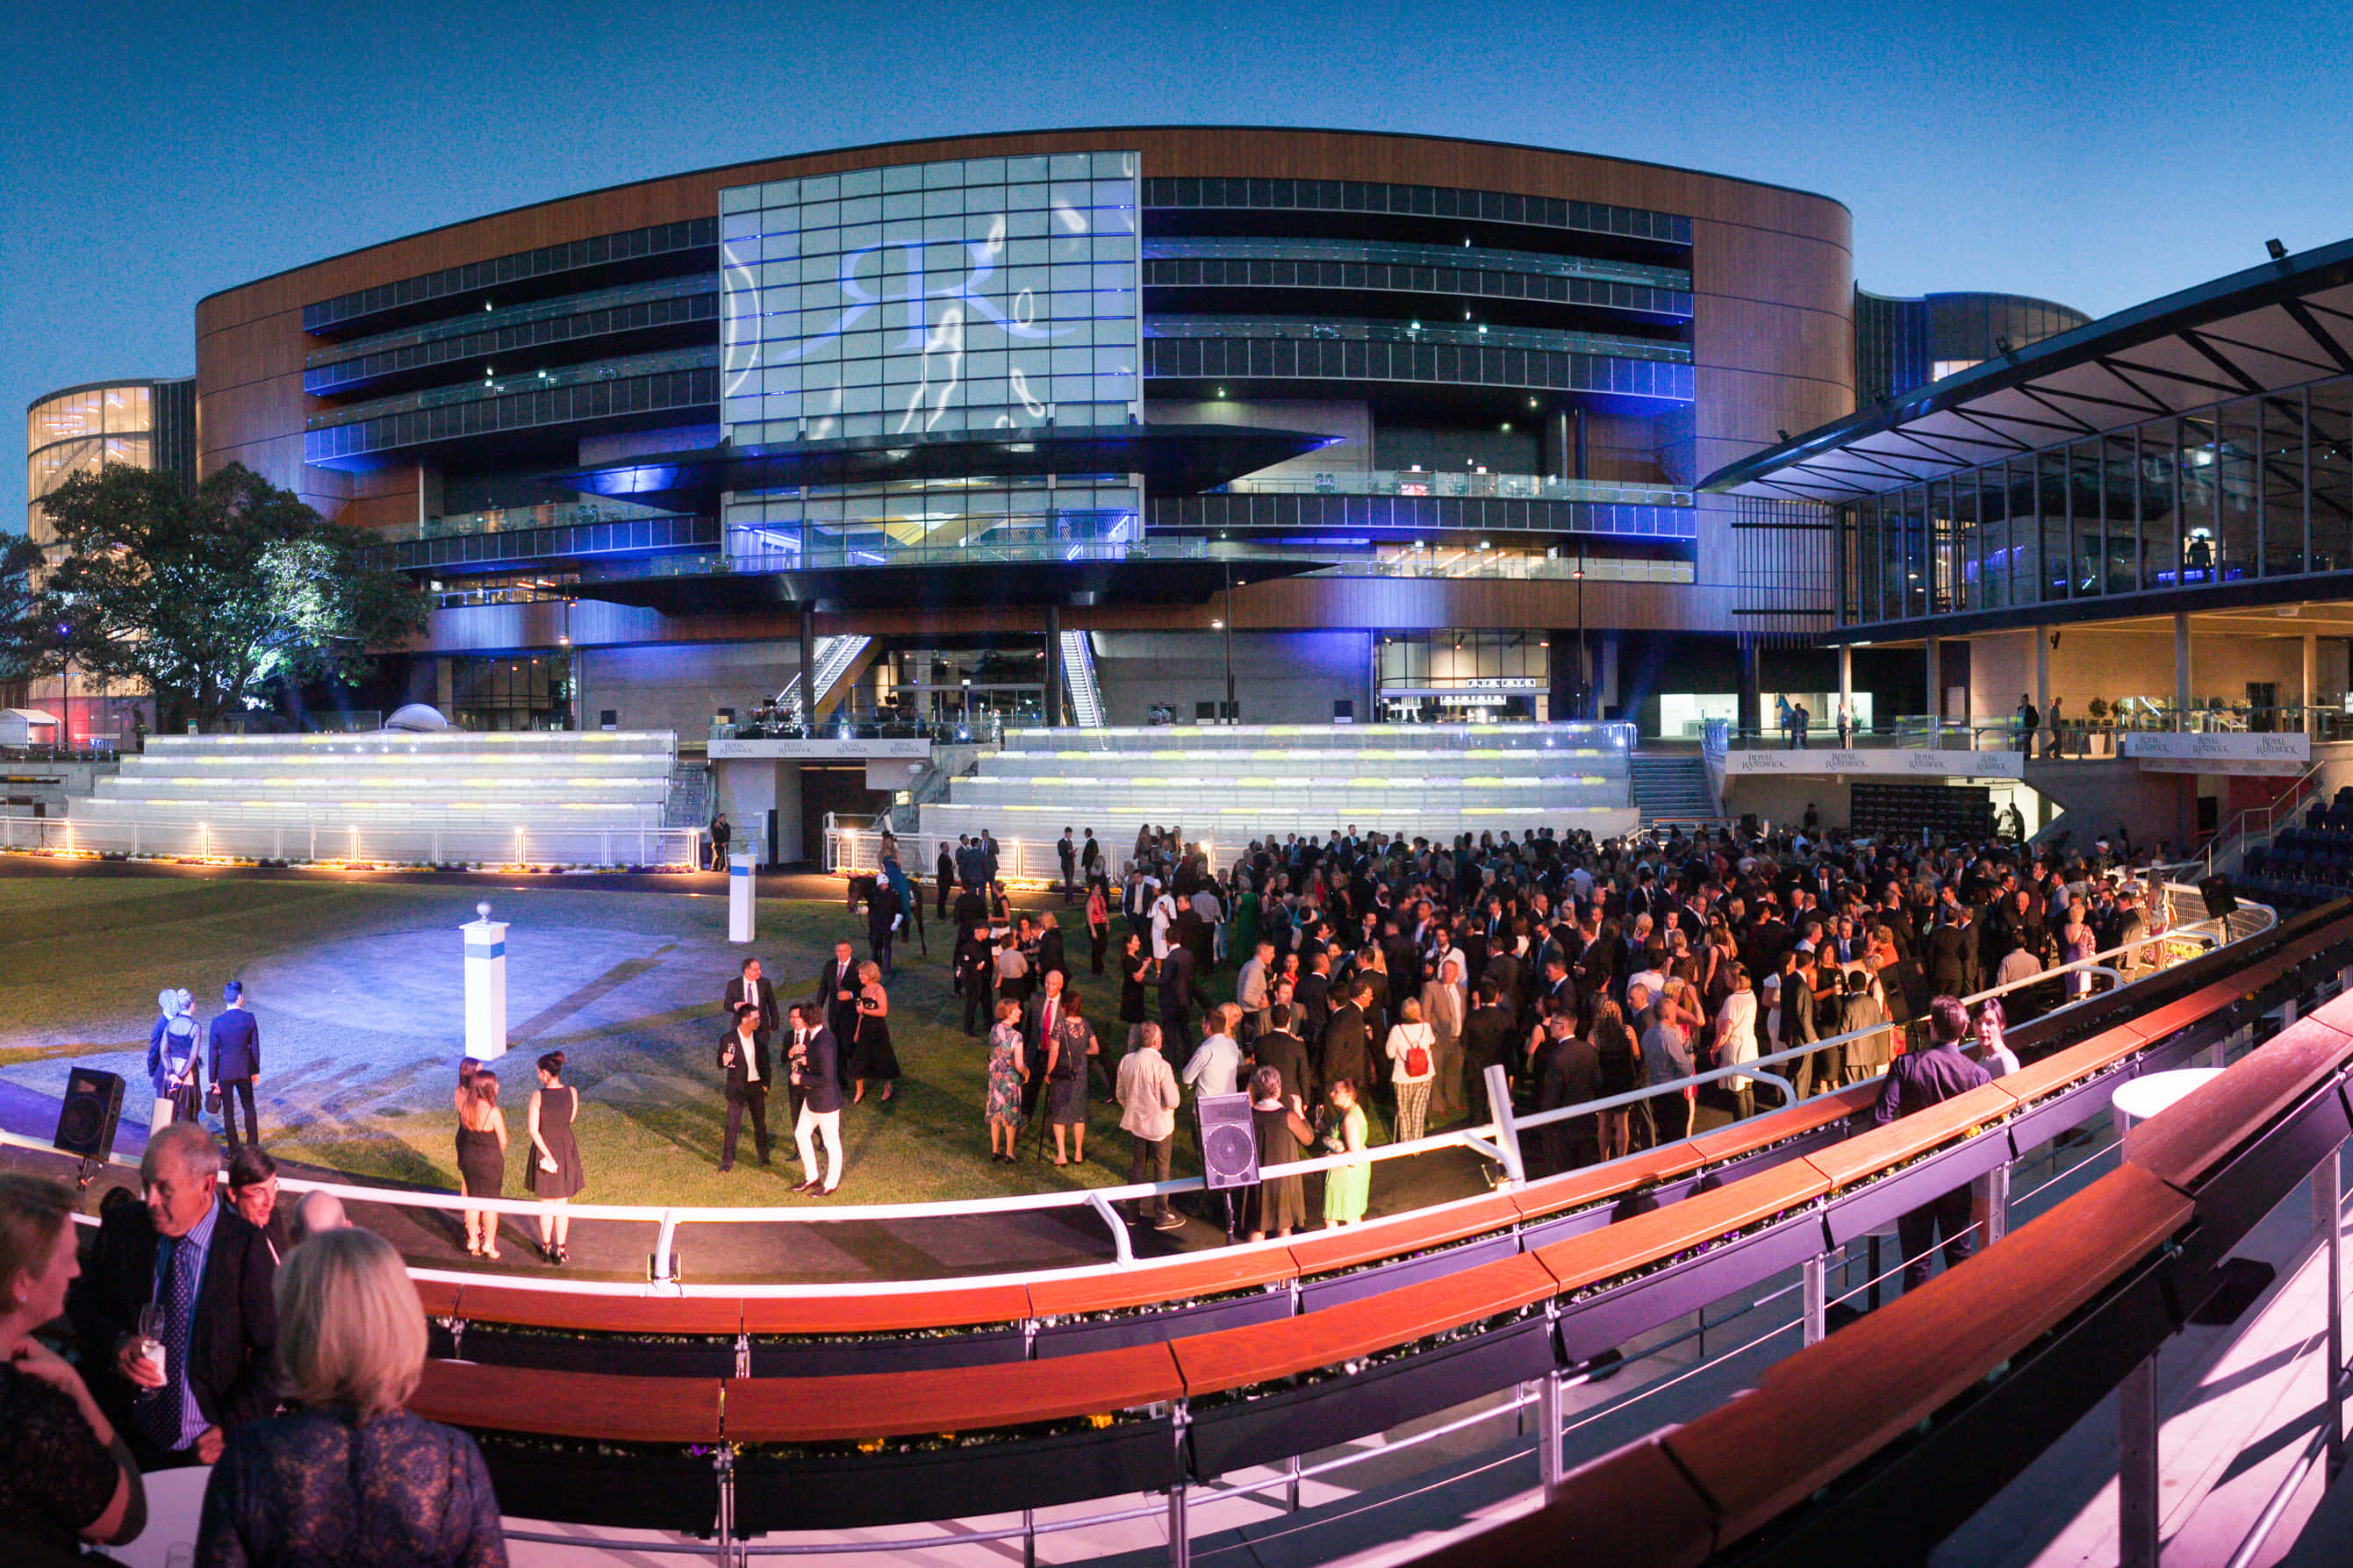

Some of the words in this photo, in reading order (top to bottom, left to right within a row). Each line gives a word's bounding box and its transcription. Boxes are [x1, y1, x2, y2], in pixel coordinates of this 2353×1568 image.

[2256, 744, 2299, 755] RANDWICK
[1741, 760, 1788, 770] RANDWICK
[1826, 759, 1869, 770] RANDWICK
